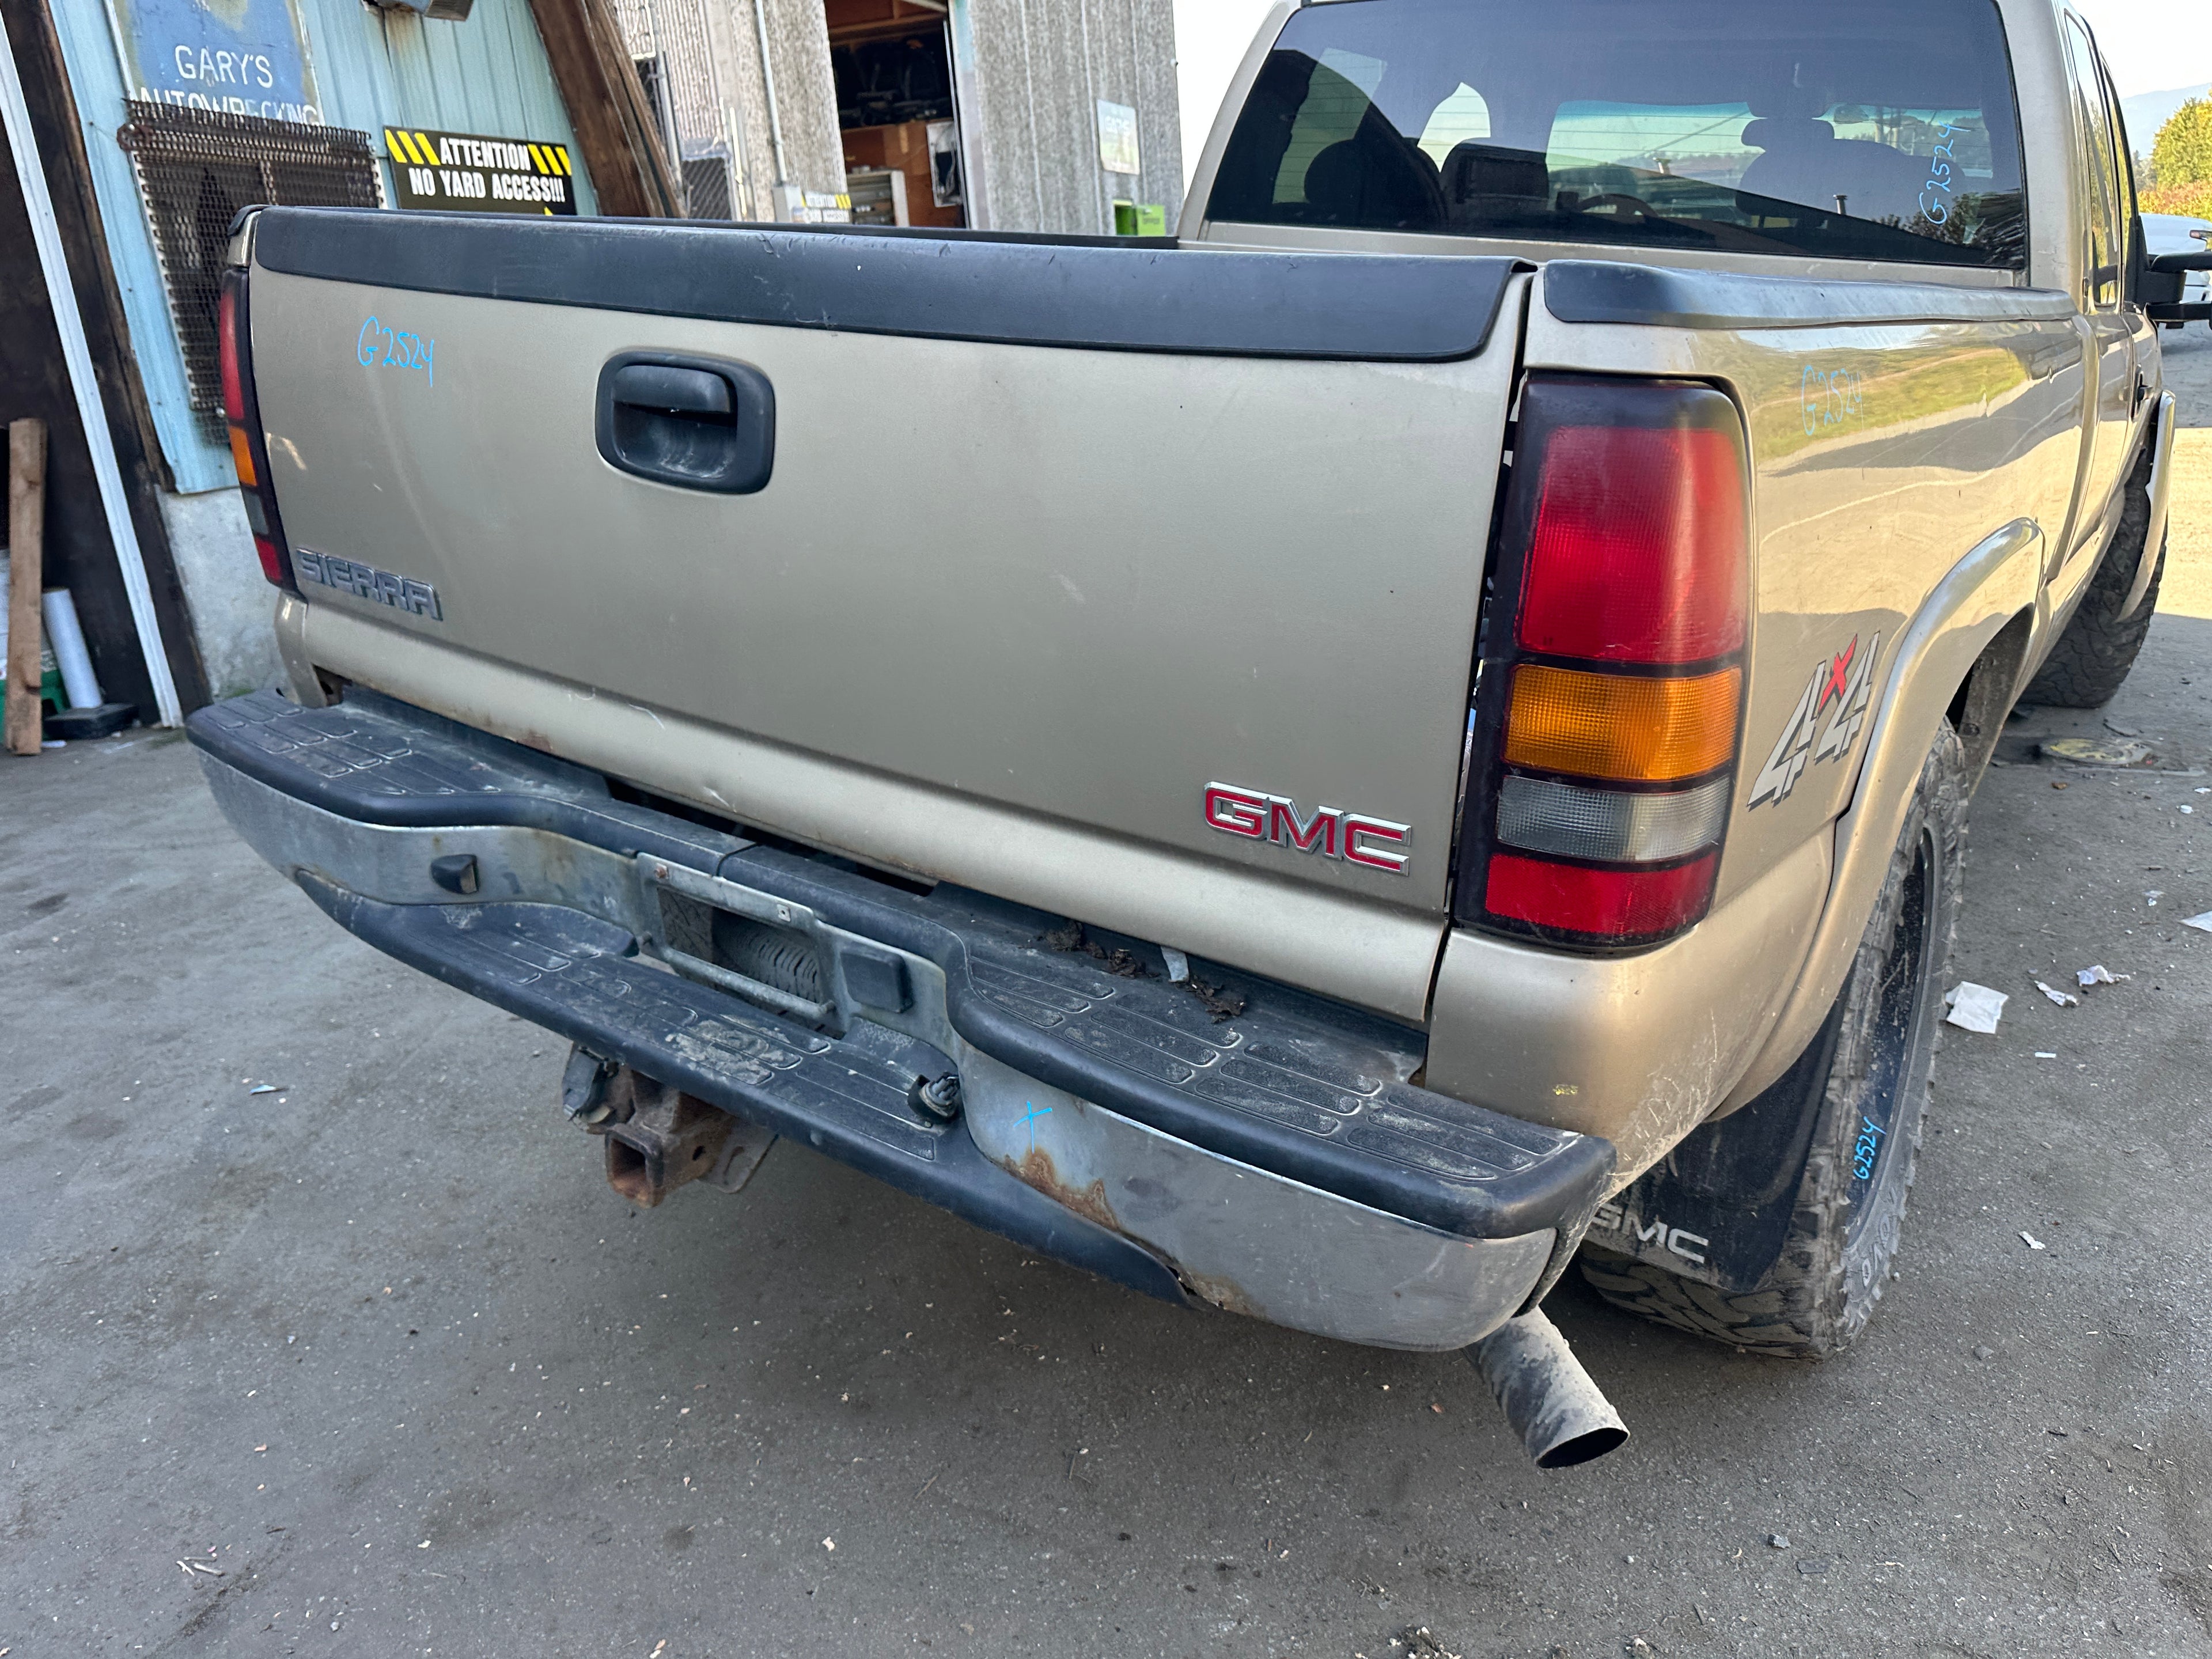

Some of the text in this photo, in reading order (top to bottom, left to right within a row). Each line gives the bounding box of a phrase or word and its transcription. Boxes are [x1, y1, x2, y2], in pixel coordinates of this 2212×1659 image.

[175, 44, 274, 88] GARY'S
[408, 167, 565, 202] NO YARD ACCESS!!!
[440, 137, 531, 171] ATTENTION
[1919, 120, 1971, 225] G2524
[357, 316, 434, 388] G2524
[296, 547, 444, 621] SIERRA
[1204, 781, 1411, 876] GMC
[1853, 1116, 1887, 1180] G2524
[1590, 1202, 1709, 1264] GMC
